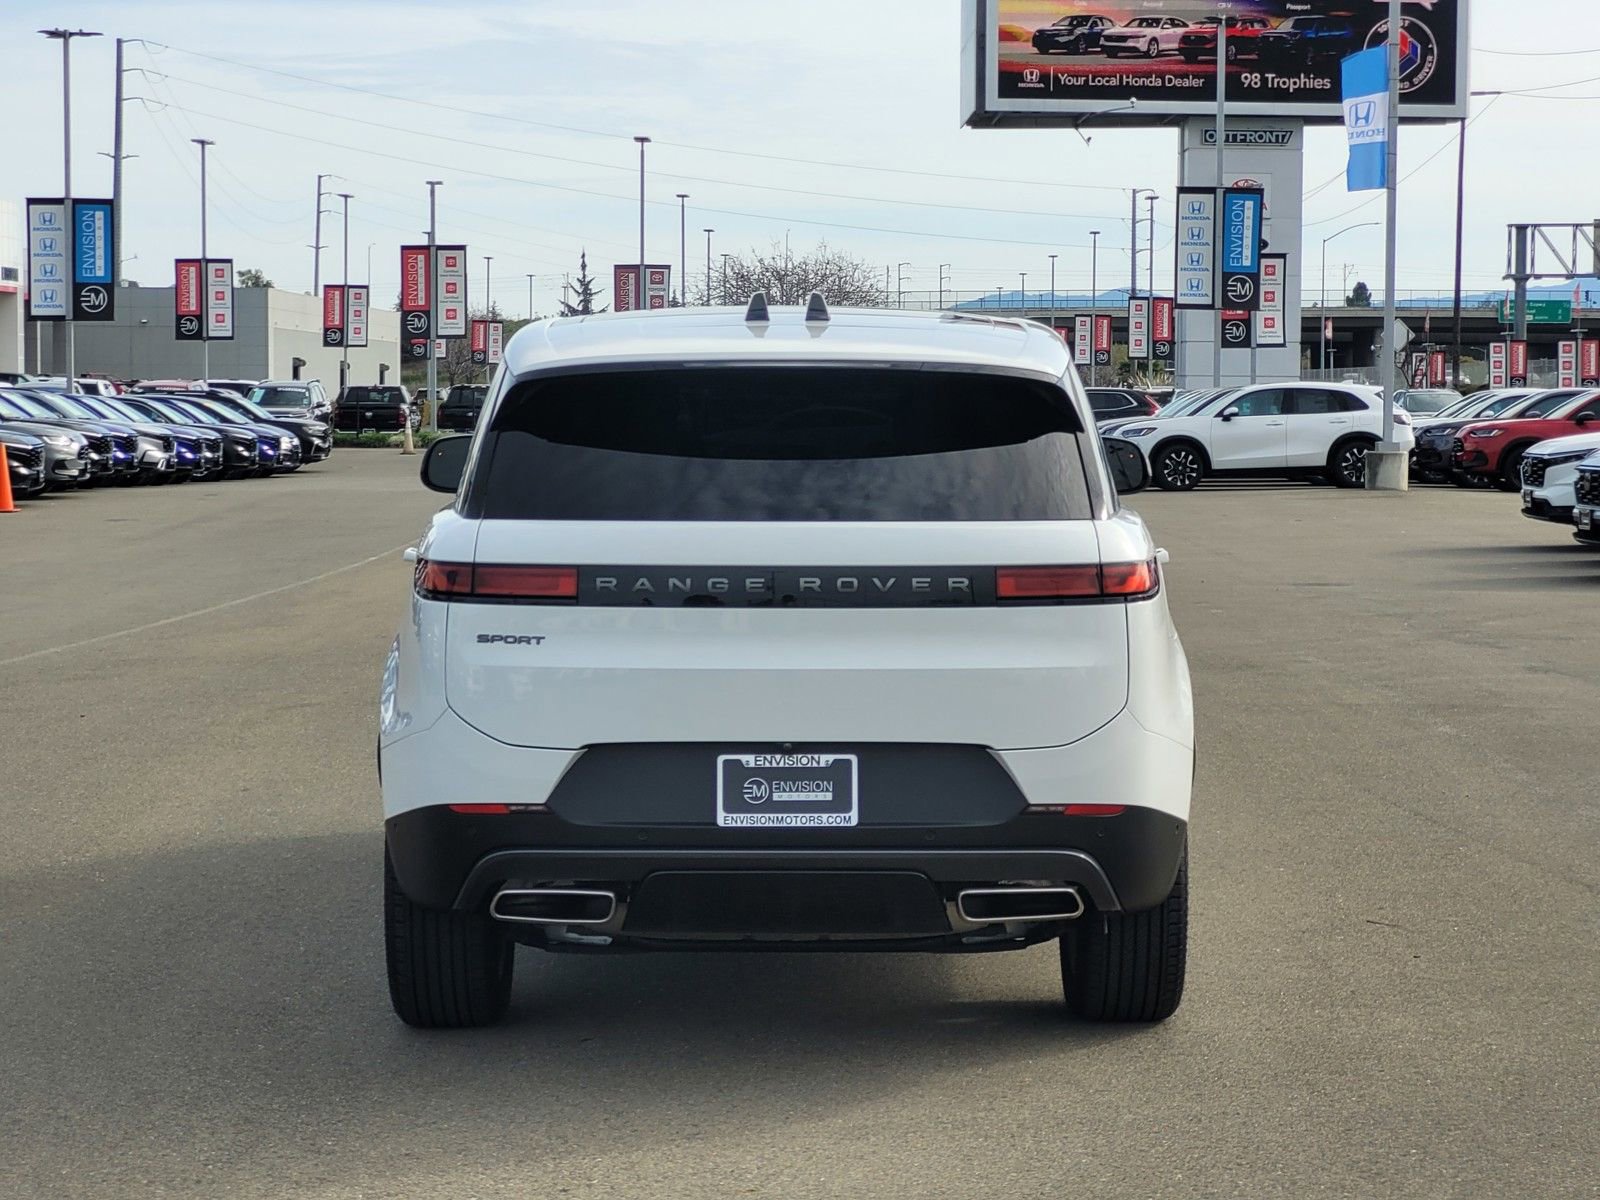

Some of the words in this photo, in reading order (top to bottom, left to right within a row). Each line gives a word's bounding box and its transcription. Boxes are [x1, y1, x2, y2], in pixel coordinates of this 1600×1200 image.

[1058, 73, 1086, 86] Your
[1088, 73, 1120, 86] Local
[1123, 74, 1162, 87] Honda
[1165, 74, 1205, 88] Dealer
[1240, 73, 1261, 88] 98
[1264, 72, 1332, 92] Trophies
[1230, 200, 1244, 266] ENVISION
[82, 210, 95, 277] ENVISION
[408, 254, 418, 305] ENVISION
[181, 266, 190, 311] ENVISION
[621, 273, 629, 310] NVISION
[596, 577, 766, 592] RANGE
[800, 577, 971, 592] ROVER
[476, 634, 546, 645] SPORT
[754, 756, 820, 766] ENVISION
[772, 781, 833, 792] ENVISION
[723, 816, 852, 825] ENVISIONMOTORS.COM
